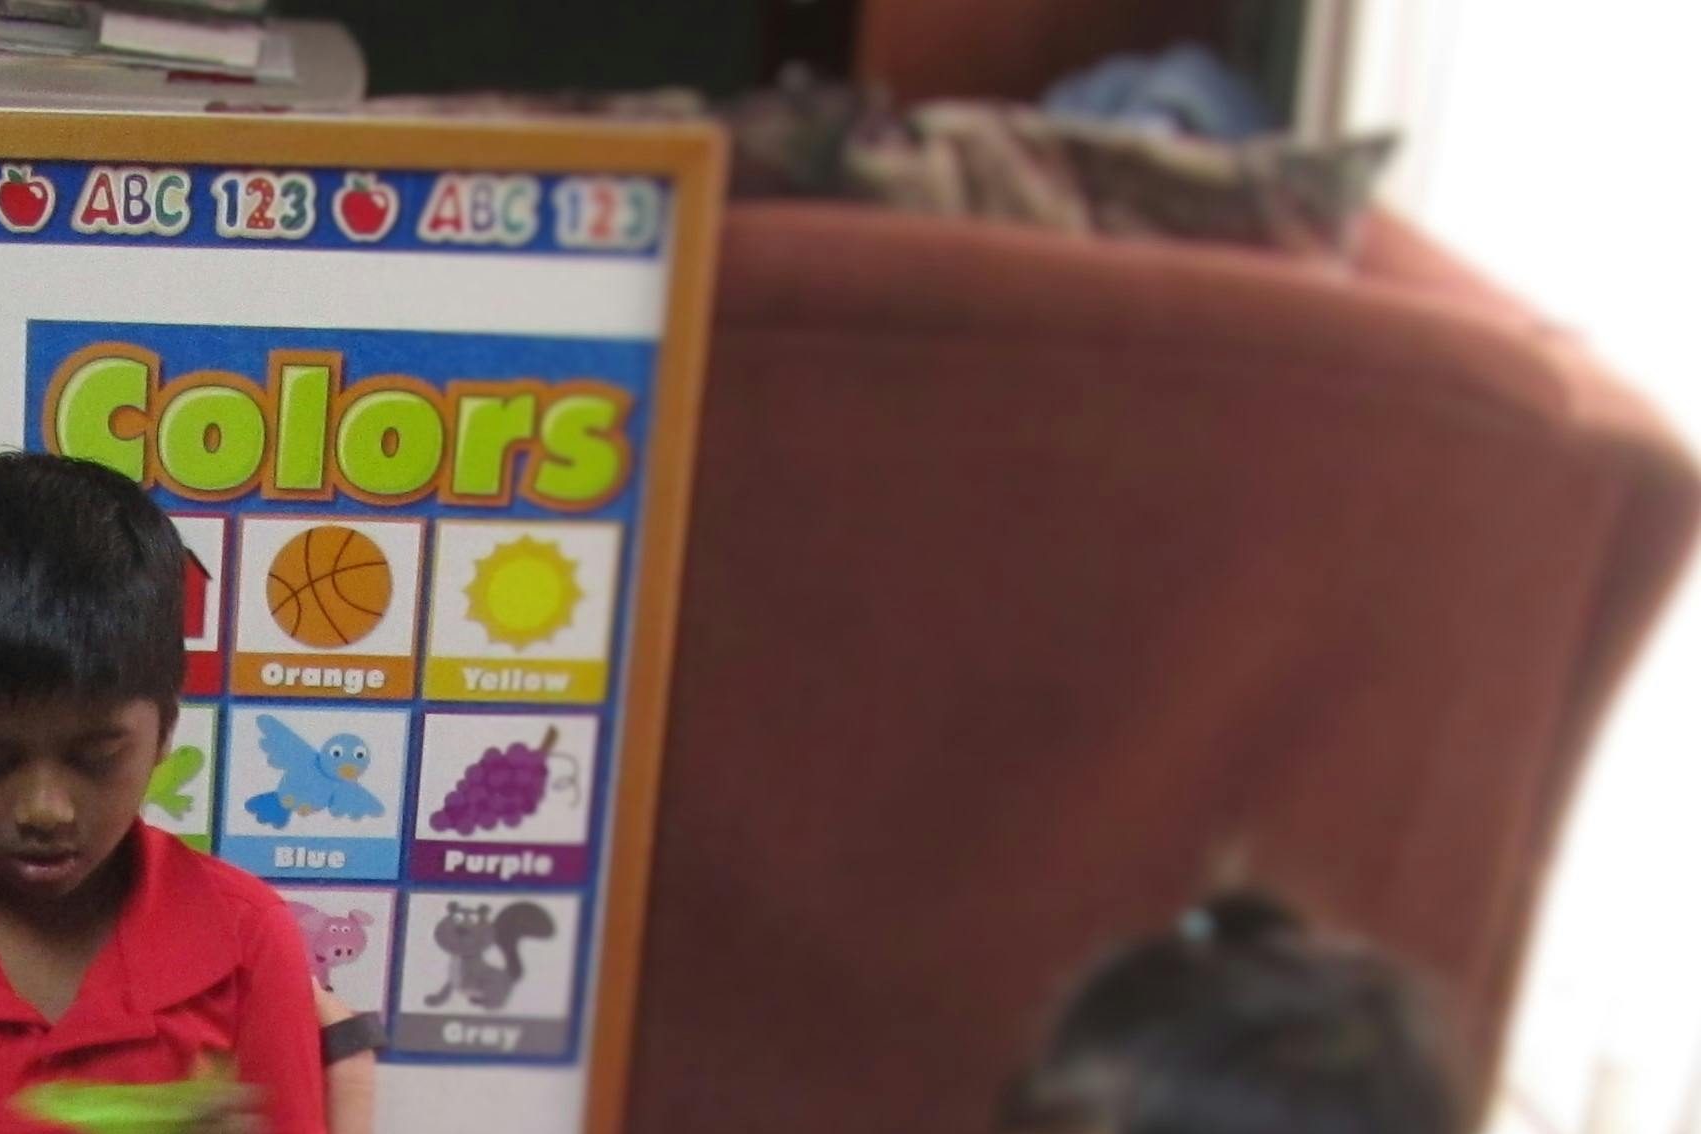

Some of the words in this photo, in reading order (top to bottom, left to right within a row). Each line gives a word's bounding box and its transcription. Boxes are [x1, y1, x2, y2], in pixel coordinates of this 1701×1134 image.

[78, 171, 187, 227] ABC
[221, 175, 311, 231] 123
[427, 180, 532, 237] ABC
[561, 181, 651, 241] 123
[51, 354, 624, 503] Colors
[260, 661, 386, 695] Orange
[461, 666, 570, 692] Yellow
[272, 846, 347, 870] Blue
[443, 850, 555, 881] Purple
[442, 1018, 523, 1049] Gray
